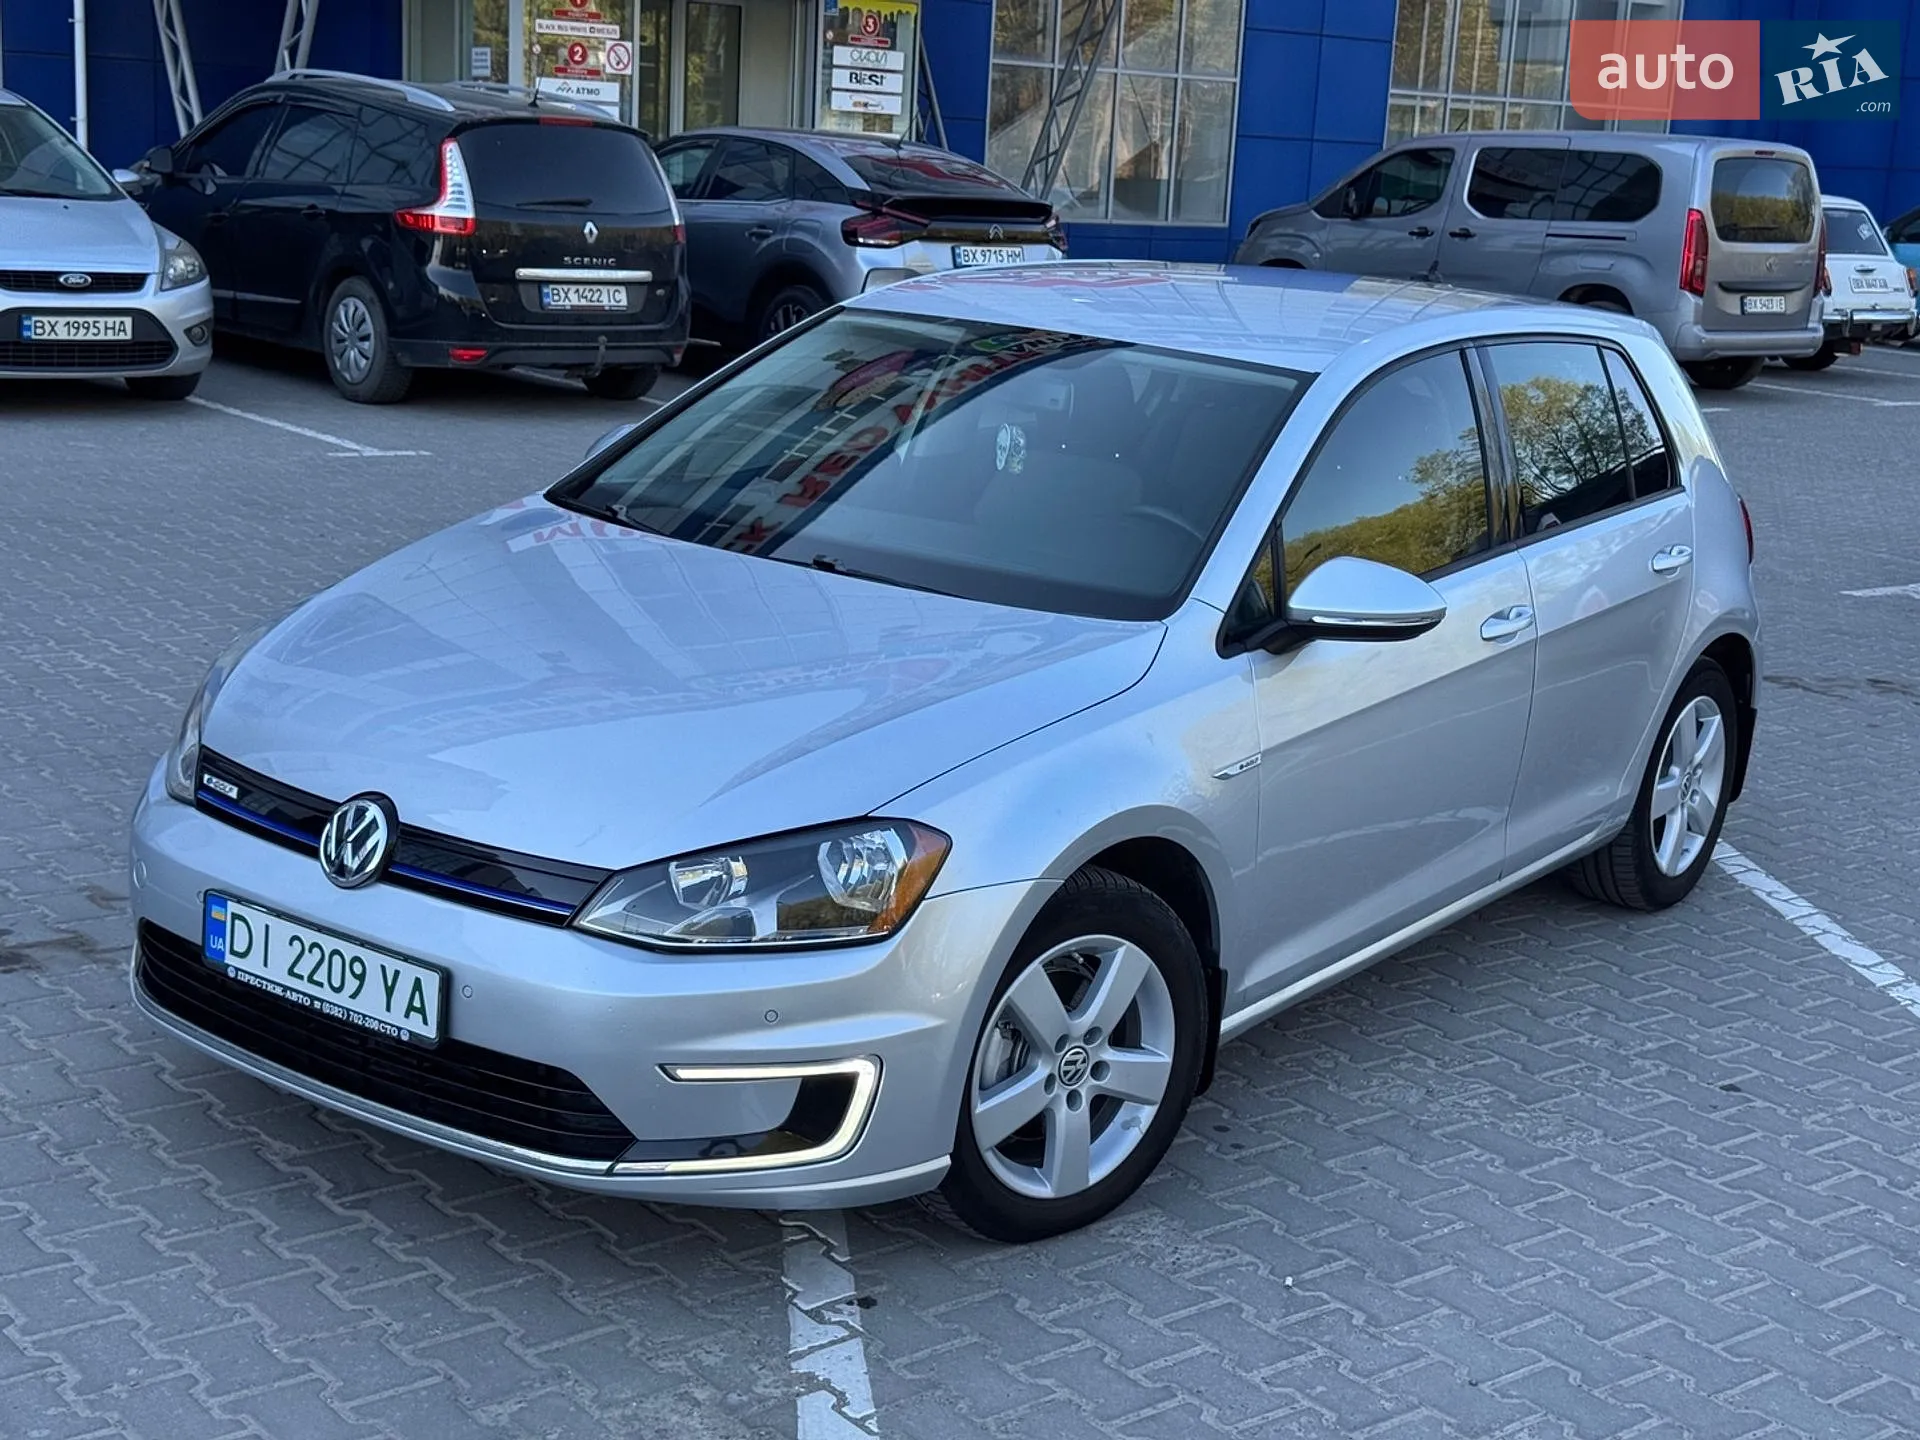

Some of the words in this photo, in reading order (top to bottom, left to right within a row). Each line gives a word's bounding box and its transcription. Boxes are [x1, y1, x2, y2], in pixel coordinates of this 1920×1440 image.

[864, 16, 875, 32] 3
[573, 46, 583, 61] 2
[563, 256, 617, 266] SCENIC
[962, 249, 978, 263] BX
[980, 250, 1004, 263] 9715
[550, 287, 572, 303] BX
[574, 288, 604, 304] 1422
[607, 289, 622, 303] IC
[33, 320, 59, 336] BX
[63, 320, 101, 337] 1995
[104, 320, 128, 337] HA
[210, 935, 225, 952] UA
[229, 912, 270, 968] DI
[287, 934, 368, 1000] 2209
[380, 963, 430, 1027] YA
[237, 970, 311, 1006] ПРЕСТИЖ-АВТО
[380, 1022, 399, 1037] СТО
